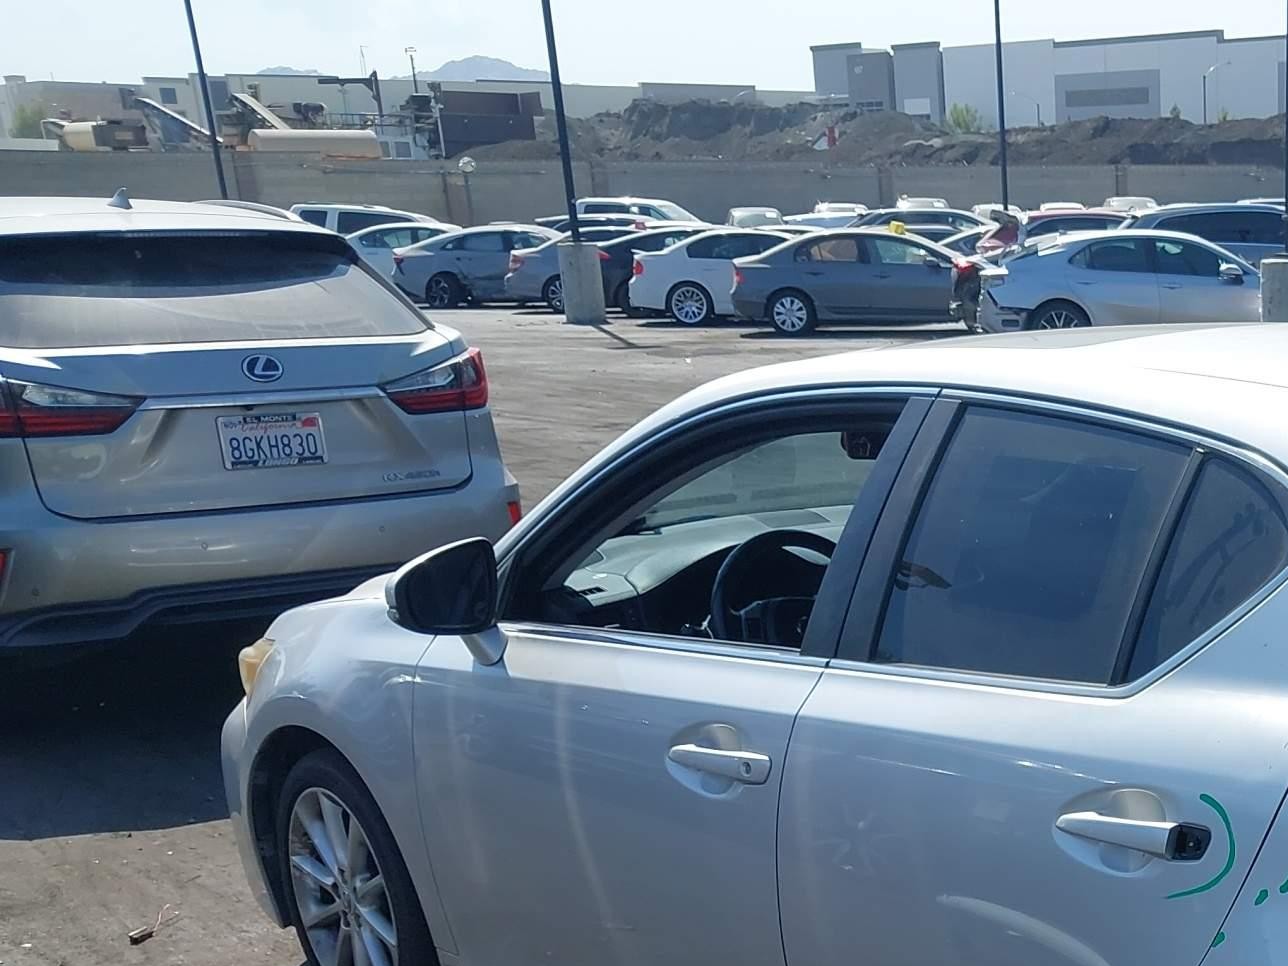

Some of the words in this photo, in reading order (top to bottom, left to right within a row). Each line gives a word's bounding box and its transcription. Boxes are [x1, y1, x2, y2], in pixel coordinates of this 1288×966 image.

[245, 416, 258, 424] EL
[260, 414, 293, 423] MONTE
[229, 432, 319, 461] 8GKH830
